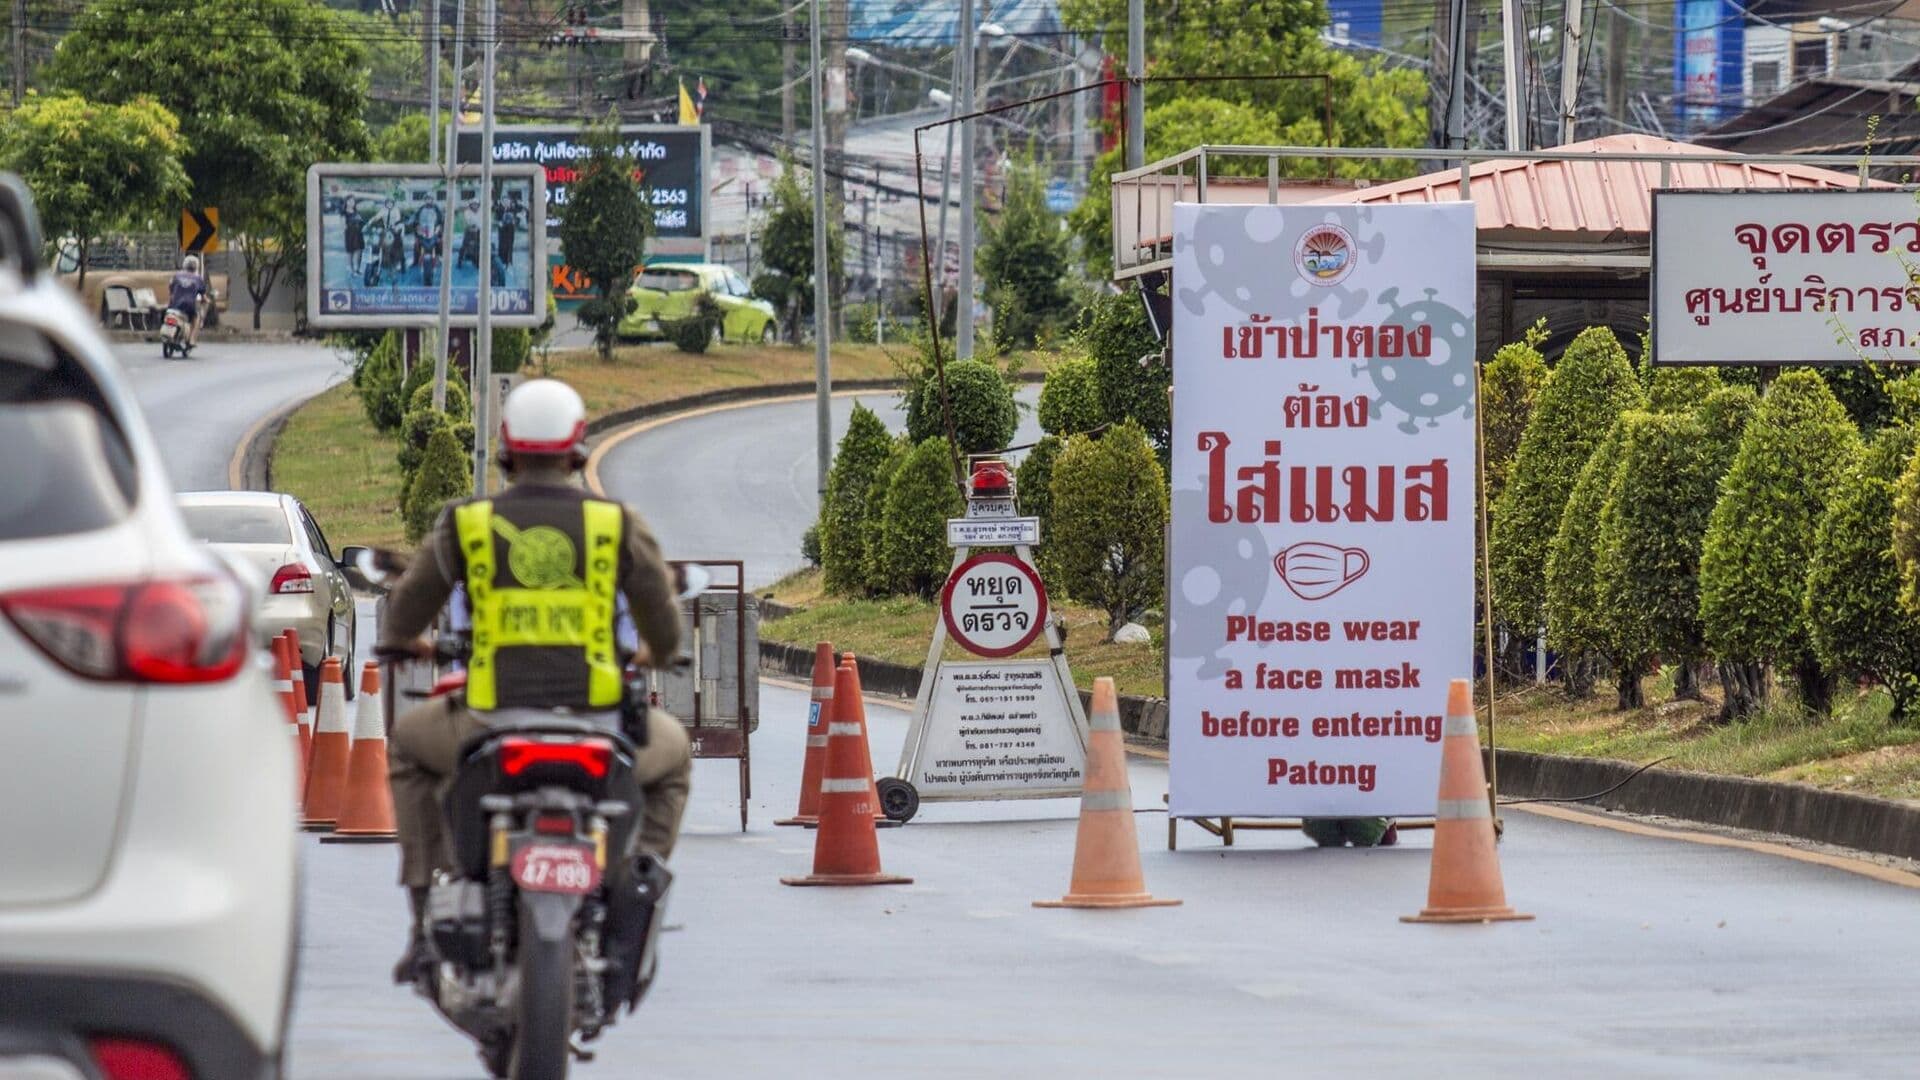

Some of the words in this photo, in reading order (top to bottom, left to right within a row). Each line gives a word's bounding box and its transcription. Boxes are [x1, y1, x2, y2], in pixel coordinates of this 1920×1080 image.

[651, 188, 688, 205] 2563
[1223, 307, 1432, 359] เข้าป่าตอง
[1283, 383, 1369, 429] ต้อง
[1197, 431, 1449, 523] ใส่แมส
[593, 535, 612, 663] POLICE
[967, 575, 1022, 604] หยุด
[963, 611, 1029, 633] ตรวจ
[1226, 615, 1331, 642] Please
[1343, 620, 1420, 642] wear
[1225, 668, 1243, 690] a
[1256, 663, 1322, 690] face
[1335, 662, 1420, 689] mask
[1201, 711, 1299, 737] before
[1312, 710, 1443, 742] entering
[1268, 758, 1377, 792] Patong
